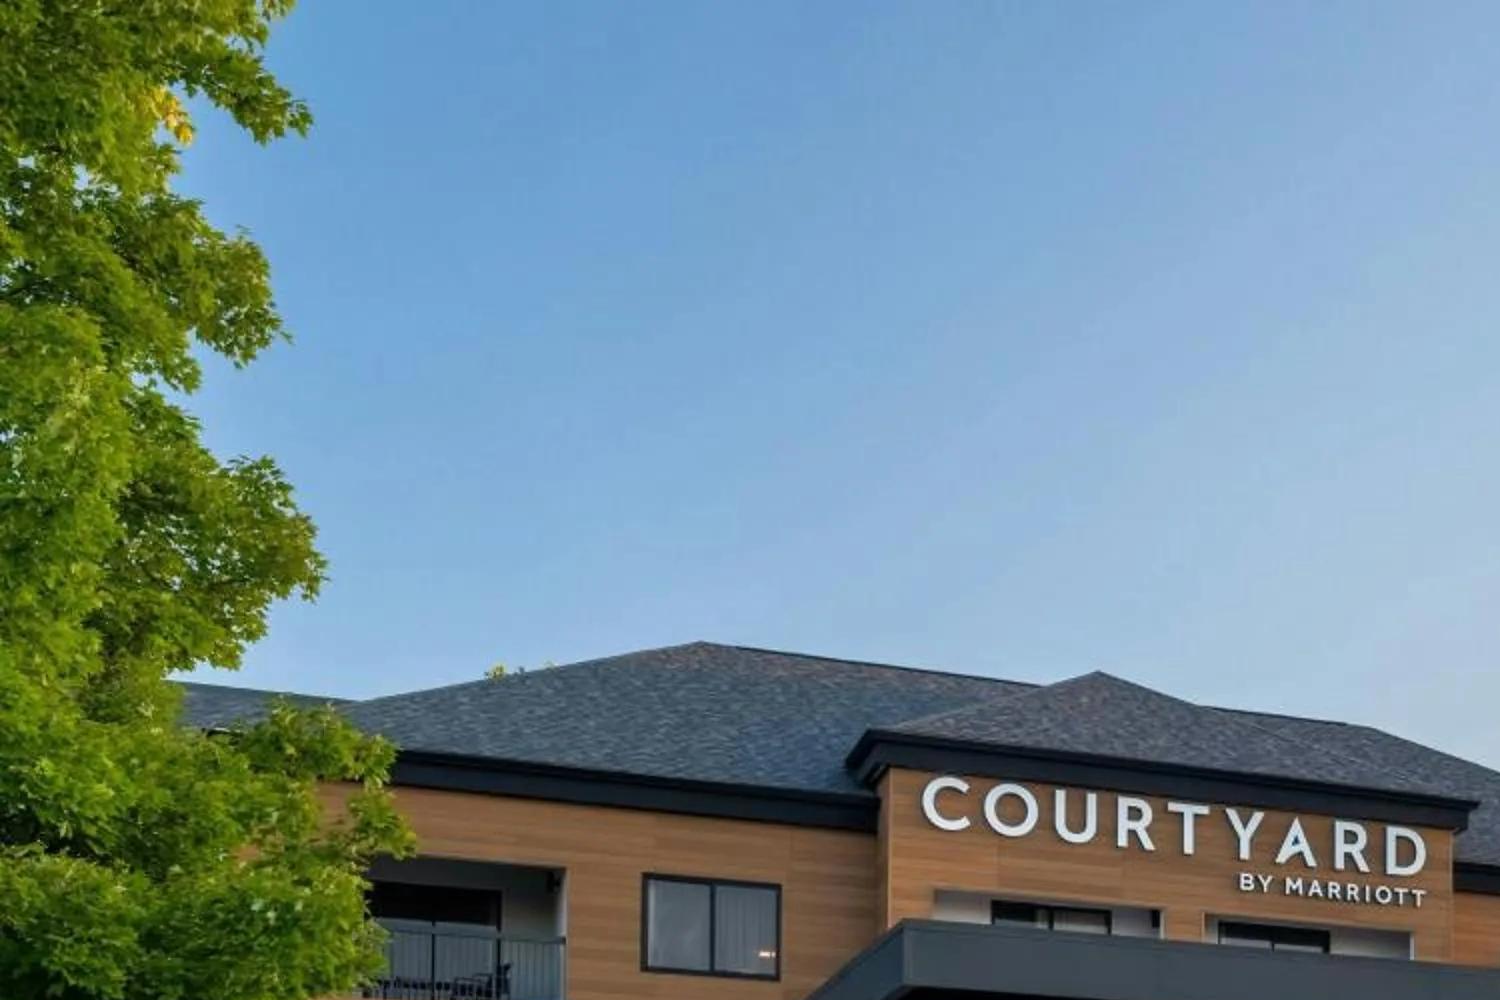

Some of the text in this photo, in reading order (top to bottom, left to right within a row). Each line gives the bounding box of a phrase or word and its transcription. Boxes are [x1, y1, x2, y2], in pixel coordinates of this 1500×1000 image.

[921, 776, 1428, 877] COURTYARD
[1239, 872, 1427, 908] BY MARRIOTT
